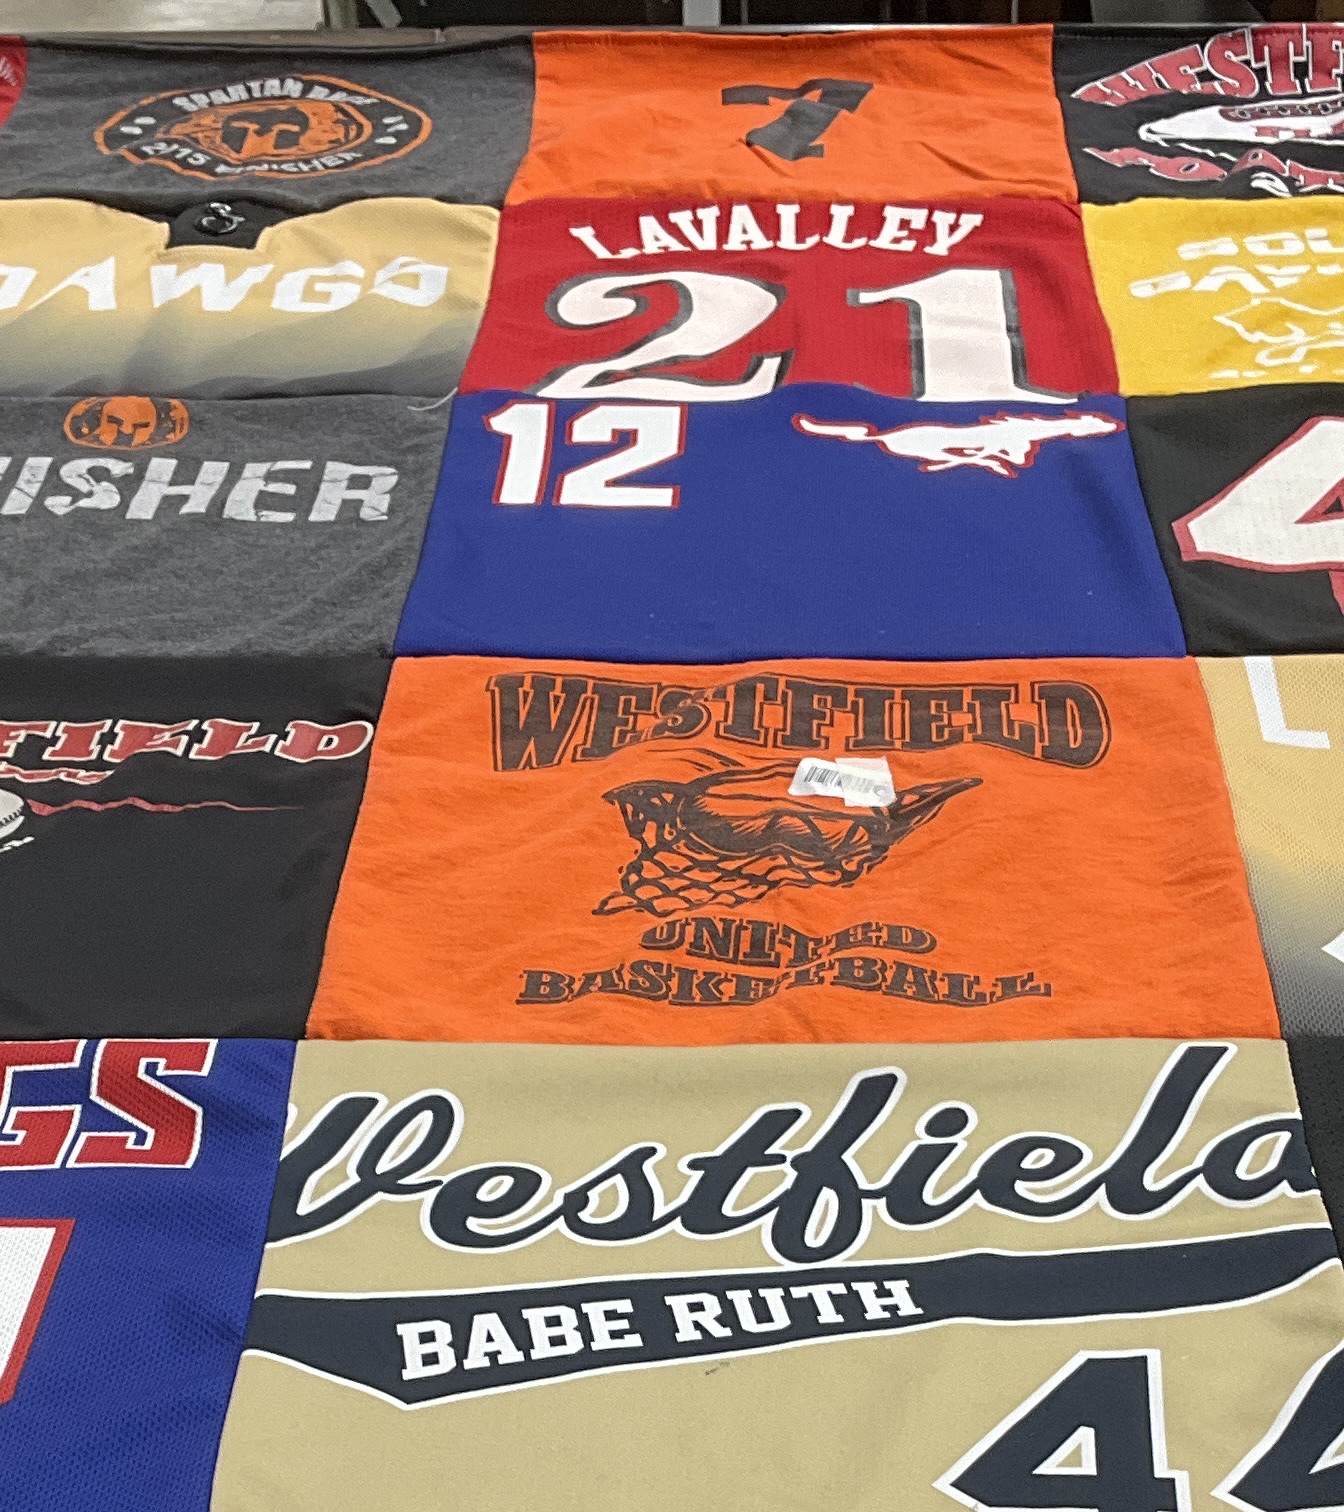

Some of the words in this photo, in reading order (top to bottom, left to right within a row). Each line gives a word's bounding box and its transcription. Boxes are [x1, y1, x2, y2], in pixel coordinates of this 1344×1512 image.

[172, 78, 303, 112] SPARTAN
[722, 78, 874, 160] 7
[569, 204, 984, 260] LAVALLEY
[528, 268, 1091, 405] 21
[484, 402, 688, 508] 12
[486, 672, 1112, 772] WESTFIELD
[515, 957, 1052, 1008] BASKETBALL
[639, 918, 937, 966] UNITED
[396, 1298, 644, 1382] BABE
[664, 1278, 923, 1348] RUTH
